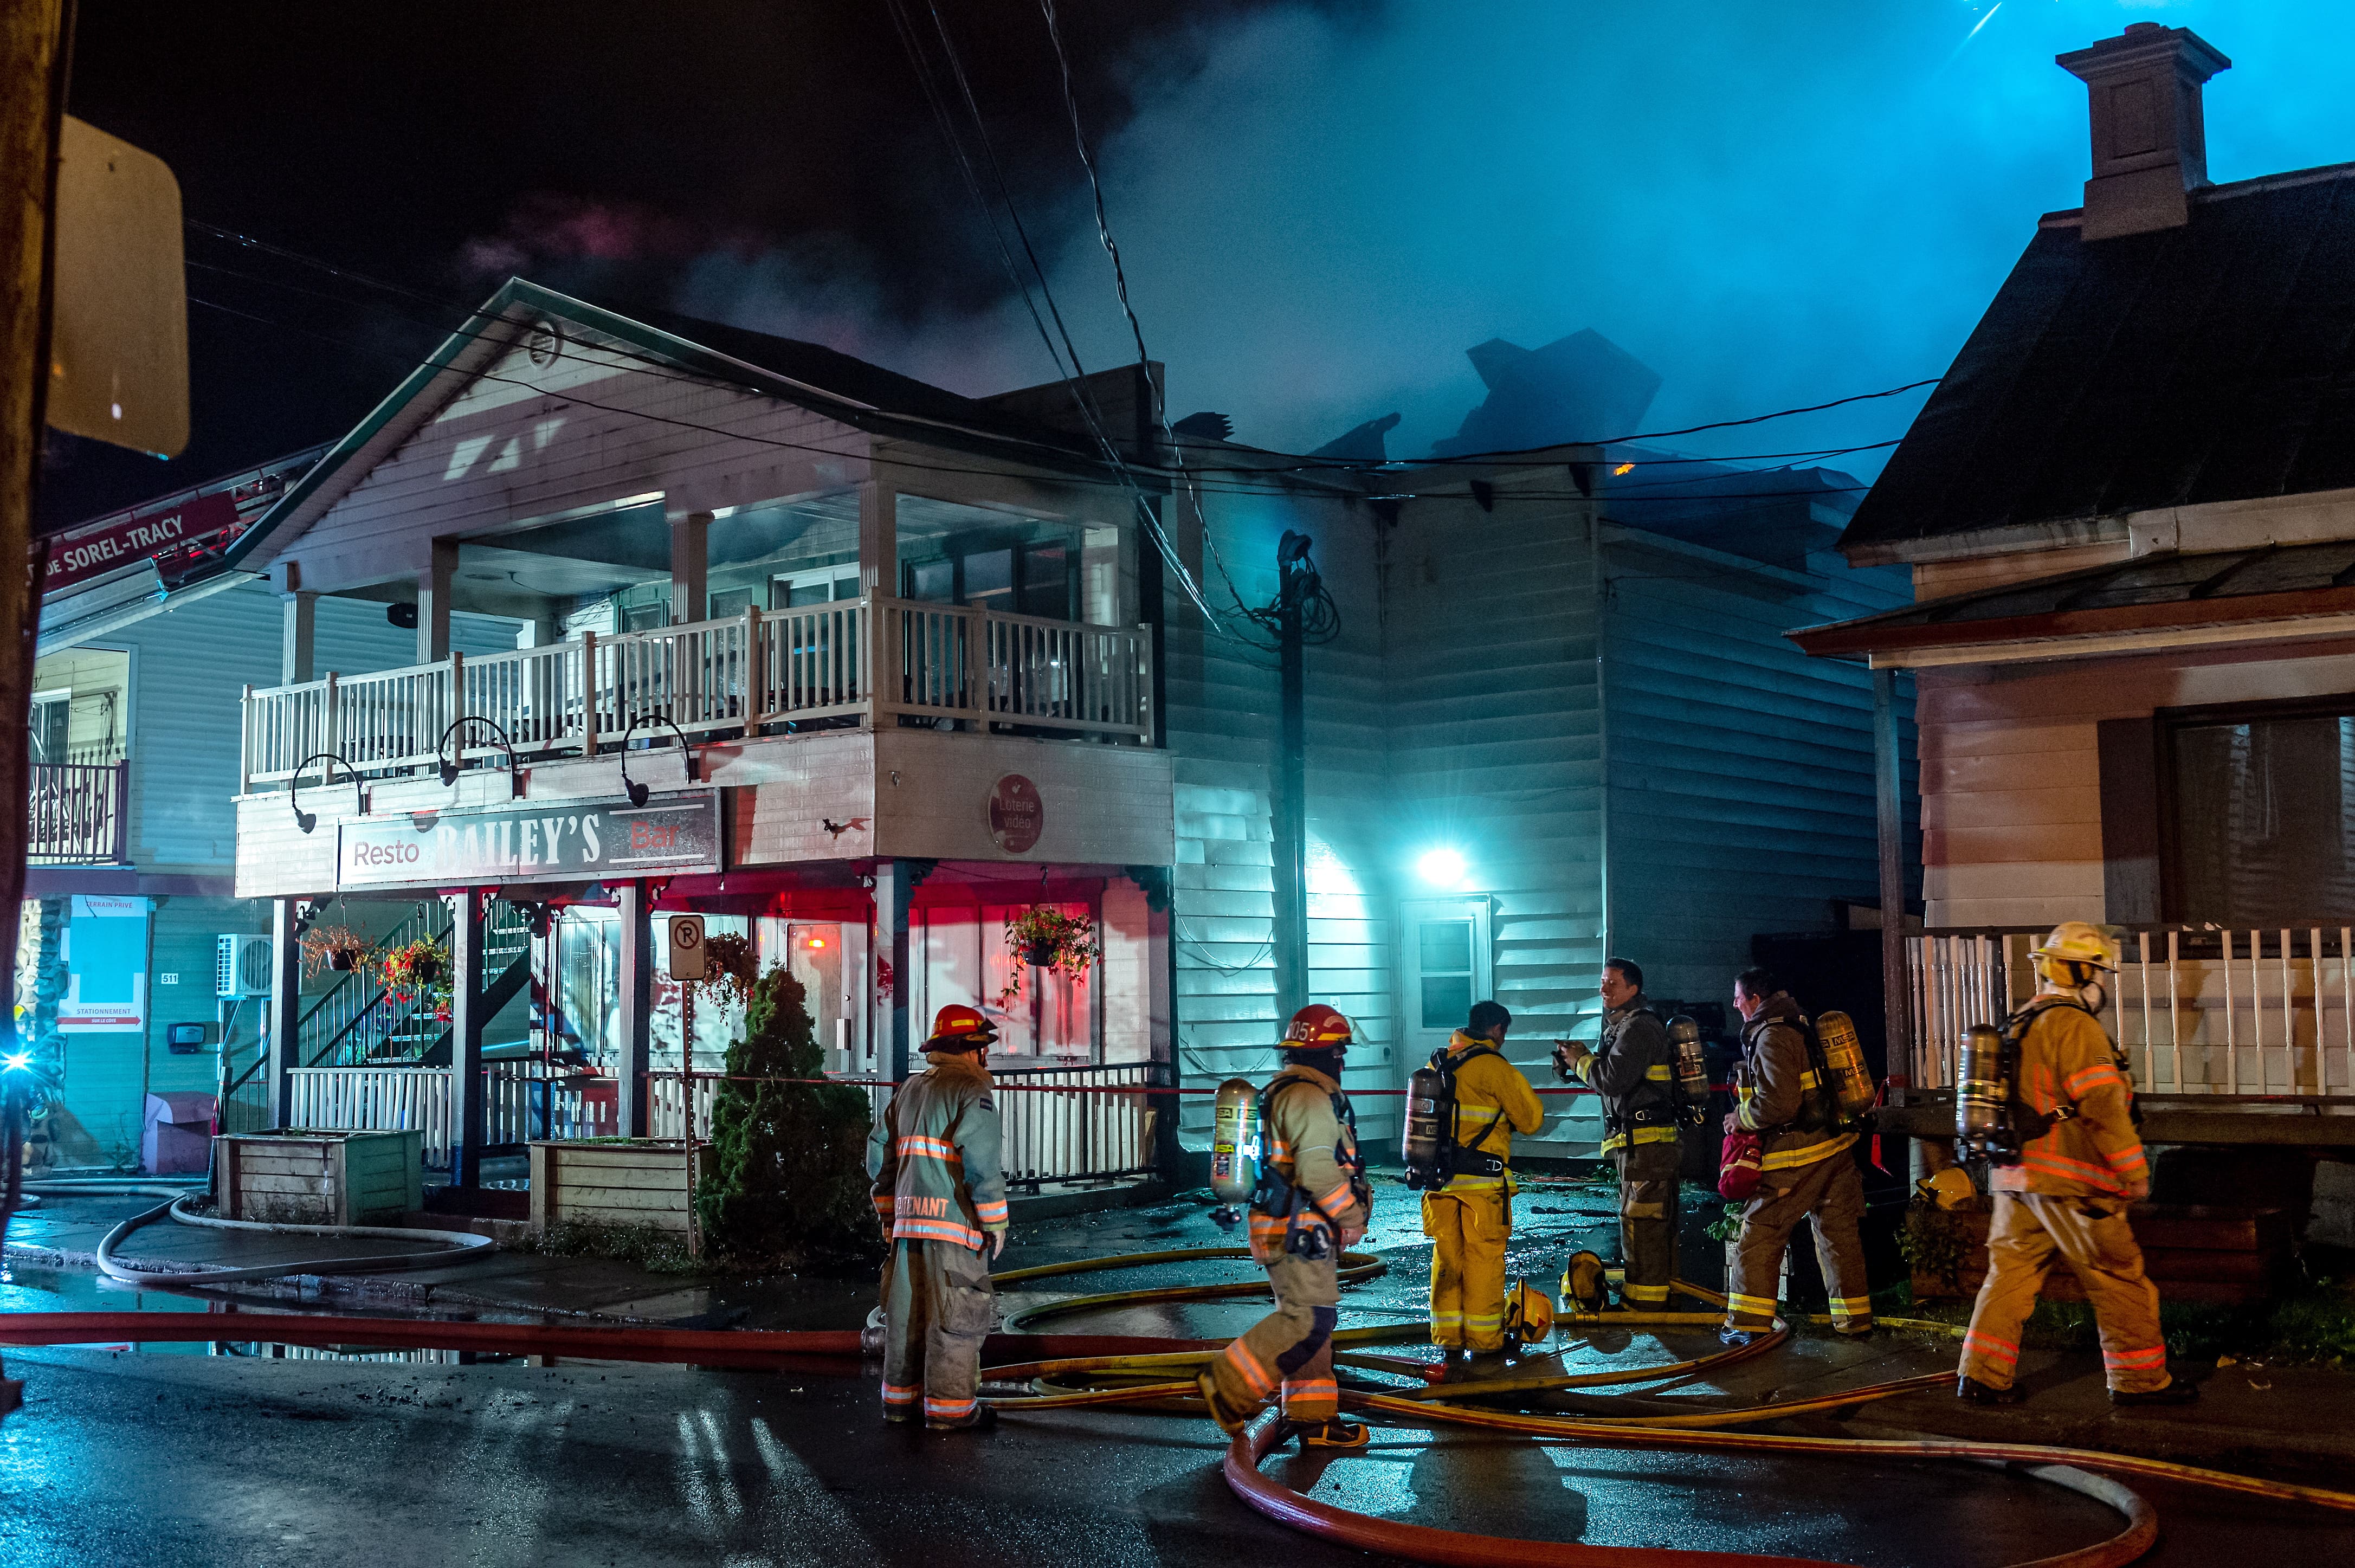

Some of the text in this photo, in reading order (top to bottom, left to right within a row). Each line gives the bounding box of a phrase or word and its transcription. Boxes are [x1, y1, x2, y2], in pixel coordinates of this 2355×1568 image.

[47, 559, 62, 576] DE
[63, 514, 183, 572] SOREL-TRACY
[999, 797, 1034, 812] Loterie
[1004, 815, 1031, 828] vidéo
[354, 814, 680, 870] Resto BAILEY'S Bar
